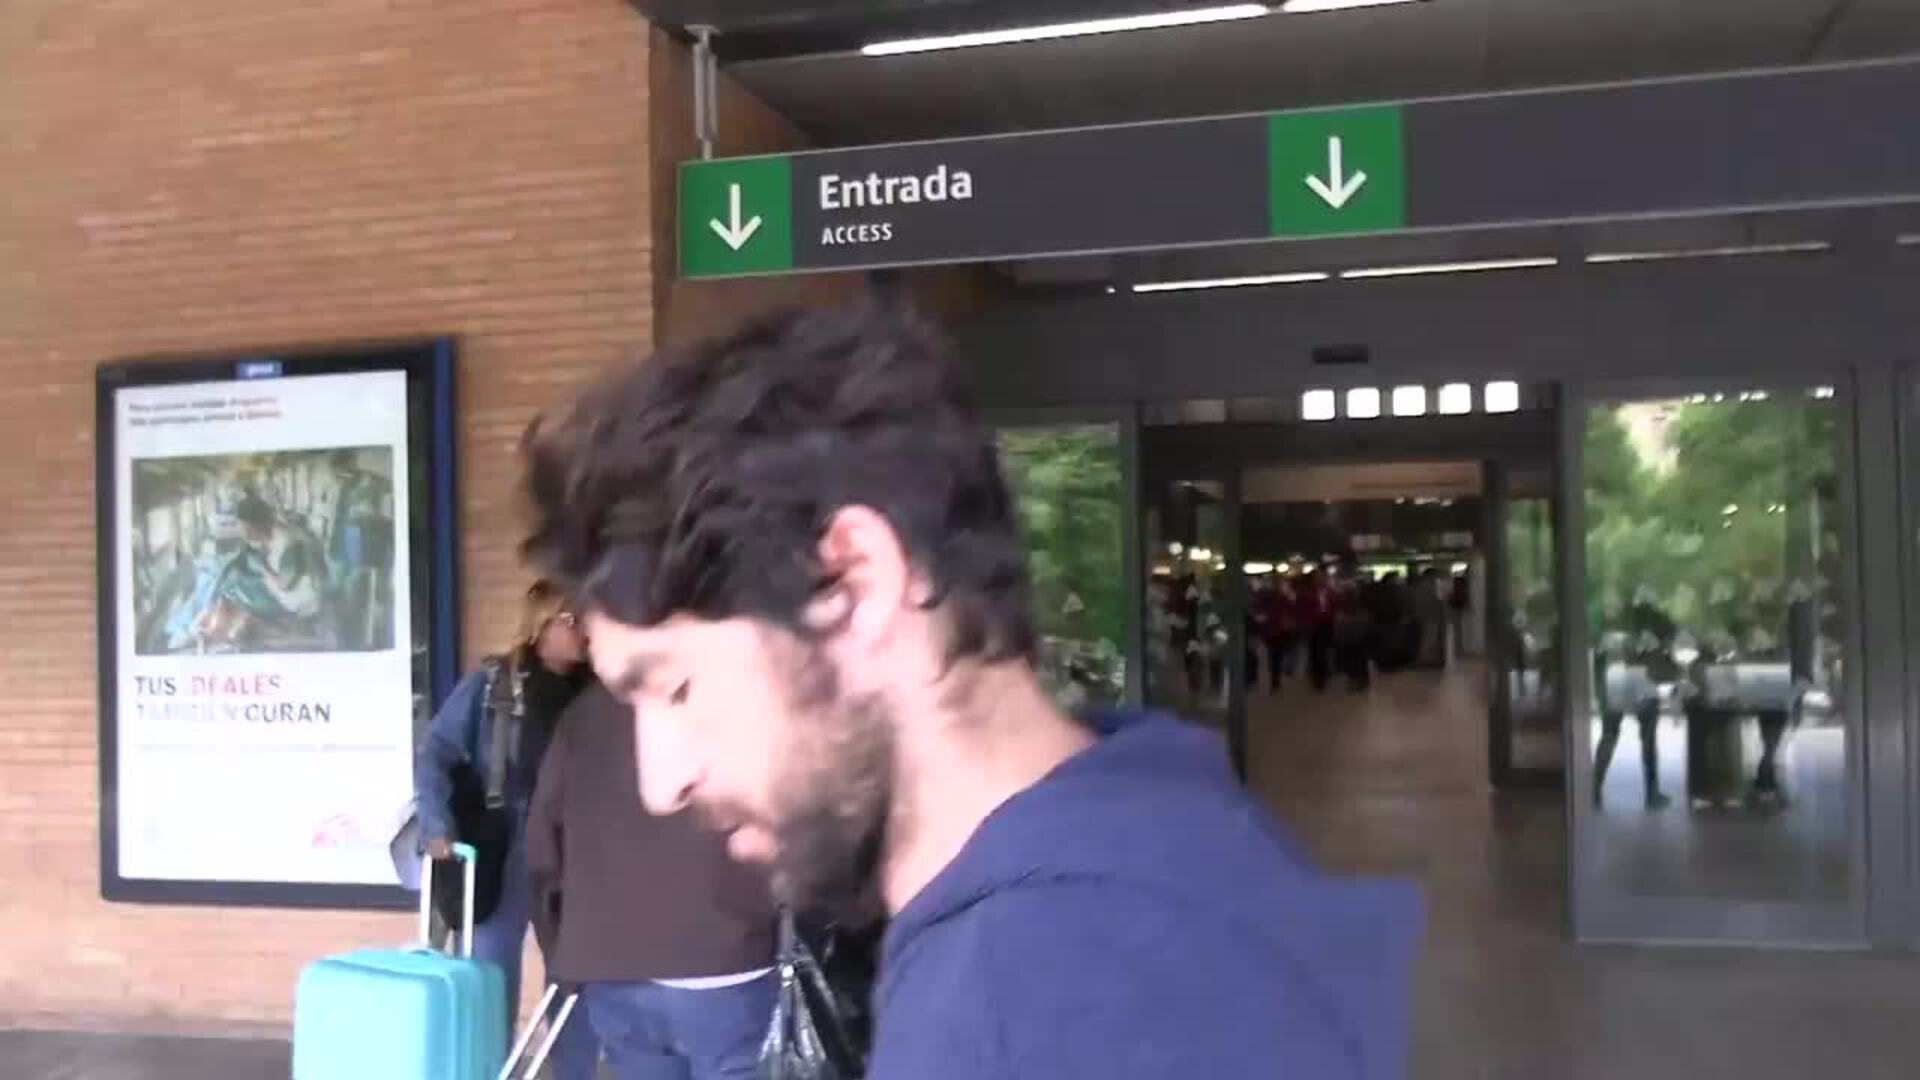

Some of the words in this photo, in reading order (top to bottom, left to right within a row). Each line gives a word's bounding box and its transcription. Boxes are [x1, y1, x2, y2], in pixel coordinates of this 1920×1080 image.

[820, 164, 973, 210] Entrada
[821, 222, 893, 245] ACCESS
[134, 675, 176, 696] TUS
[187, 674, 282, 696] DEALES
[244, 702, 331, 723] CURAN
